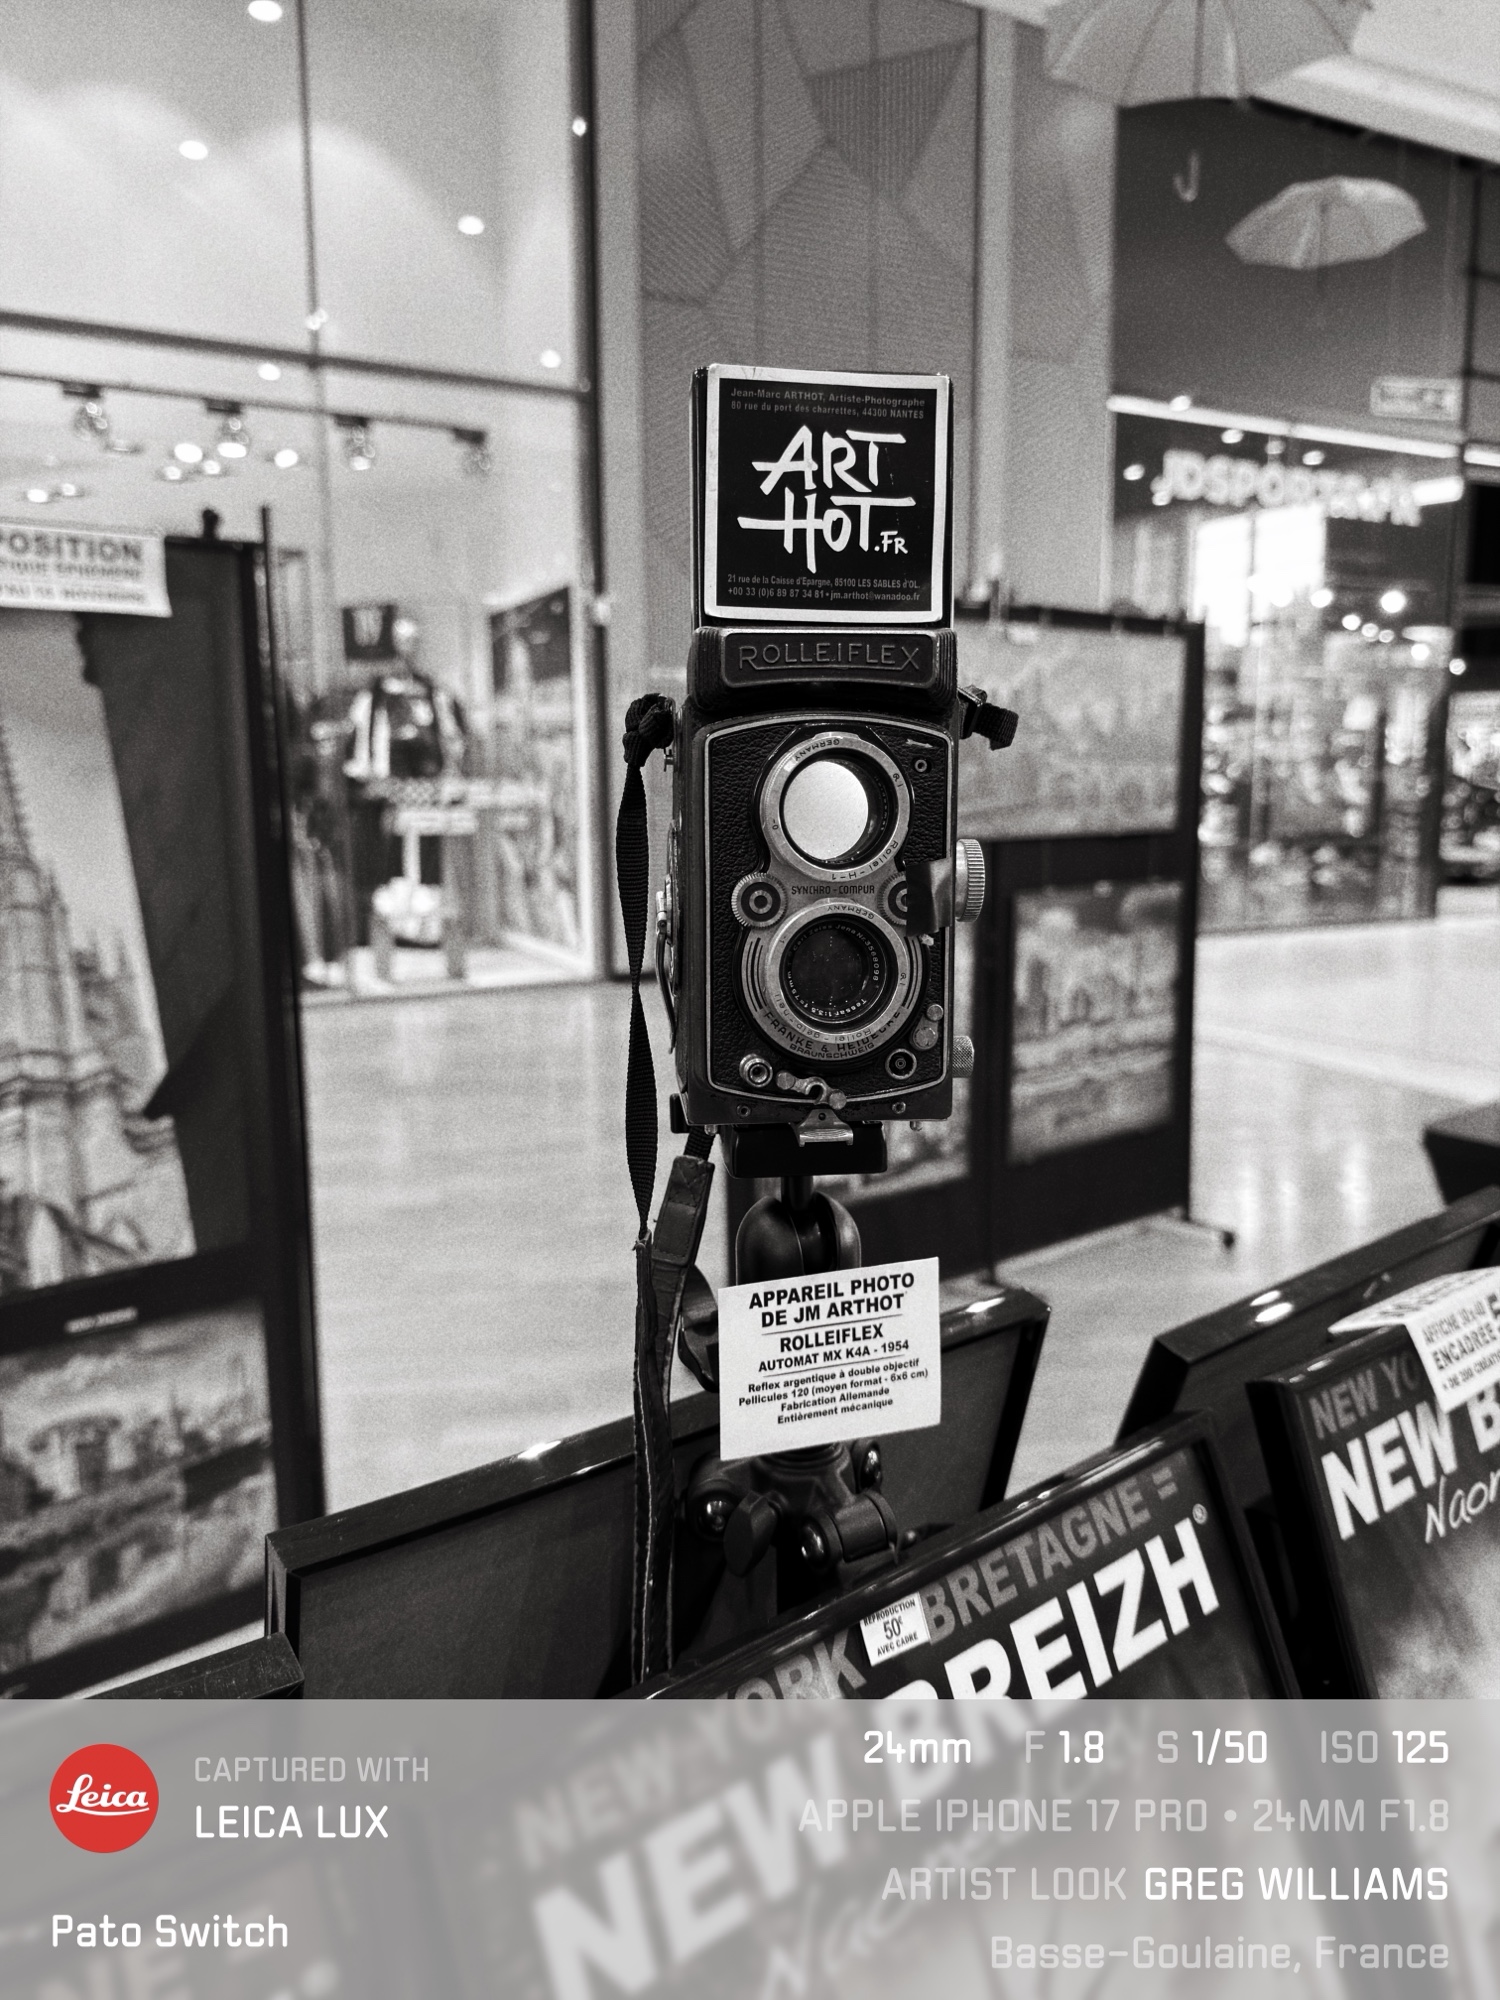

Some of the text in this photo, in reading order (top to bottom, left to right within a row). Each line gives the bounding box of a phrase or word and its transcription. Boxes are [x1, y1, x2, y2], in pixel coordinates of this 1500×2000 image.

[731, 388, 925, 408] Jean-Marc ARTHOT, Artiste-Photographe
[731, 401, 924, 419] 80 rue du port des charrettes, 44300 NANTES
[751, 424, 907, 496] ART
[0, 530, 143, 562] OSITION
[728, 574, 736, 583] 21
[738, 576, 750, 584] rue
[752, 575, 761, 584] de
[762, 575, 769, 584] la
[771, 575, 795, 585] Caisse
[834, 577, 856, 588] 85100
[858, 578, 871, 588] LES
[873, 578, 901, 589] SABLES
[728, 587, 744, 596] +00
[746, 587, 756, 596] 33
[758, 588, 775, 599] (0)6
[777, 588, 787, 598] 89
[789, 589, 800, 598] 87
[802, 589, 812, 598] 34
[738, 642, 920, 671] ROLLEIFLEX
[794, 738, 840, 762] GERMANY
[827, 905, 875, 920] GERMANY
[763, 1010, 815, 1050] FRANKE
[820, 1043, 829, 1053] &
[789, 1043, 875, 1059] BRAUNSCHWEIG
[749, 1272, 915, 1310] APPAREIL PHOTO
[761, 1293, 905, 1328] DE JM ARTHOT
[780, 1323, 884, 1353] ROLLEIFLEX
[758, 1353, 819, 1373] AUTOMAT
[823, 1349, 842, 1364] MX
[846, 1345, 870, 1359] K4A
[881, 1339, 909, 1354] 1954
[738, 1391, 789, 1407] Pellicules
[791, 1387, 810, 1399] 120
[811, 1379, 848, 1398] (moyen
[850, 1376, 883, 1389] format
[890, 1371, 908, 1383] 6x6
[910, 1367, 929, 1381] cm)
[748, 1358, 920, 1393] Reflex argentique à double objectif
[777, 1397, 894, 1425] Entièrement mécanique
[780, 1386, 891, 1412] Fabrication Allemande
[1308, 1369, 1380, 1440] NEW
[1320, 1400, 1458, 1542] NEW
[922, 1474, 1152, 1647] BRETAGNE
[863, 1598, 916, 1627] REPRODUCTION
[877, 1631, 919, 1657] AVEC CADRE
